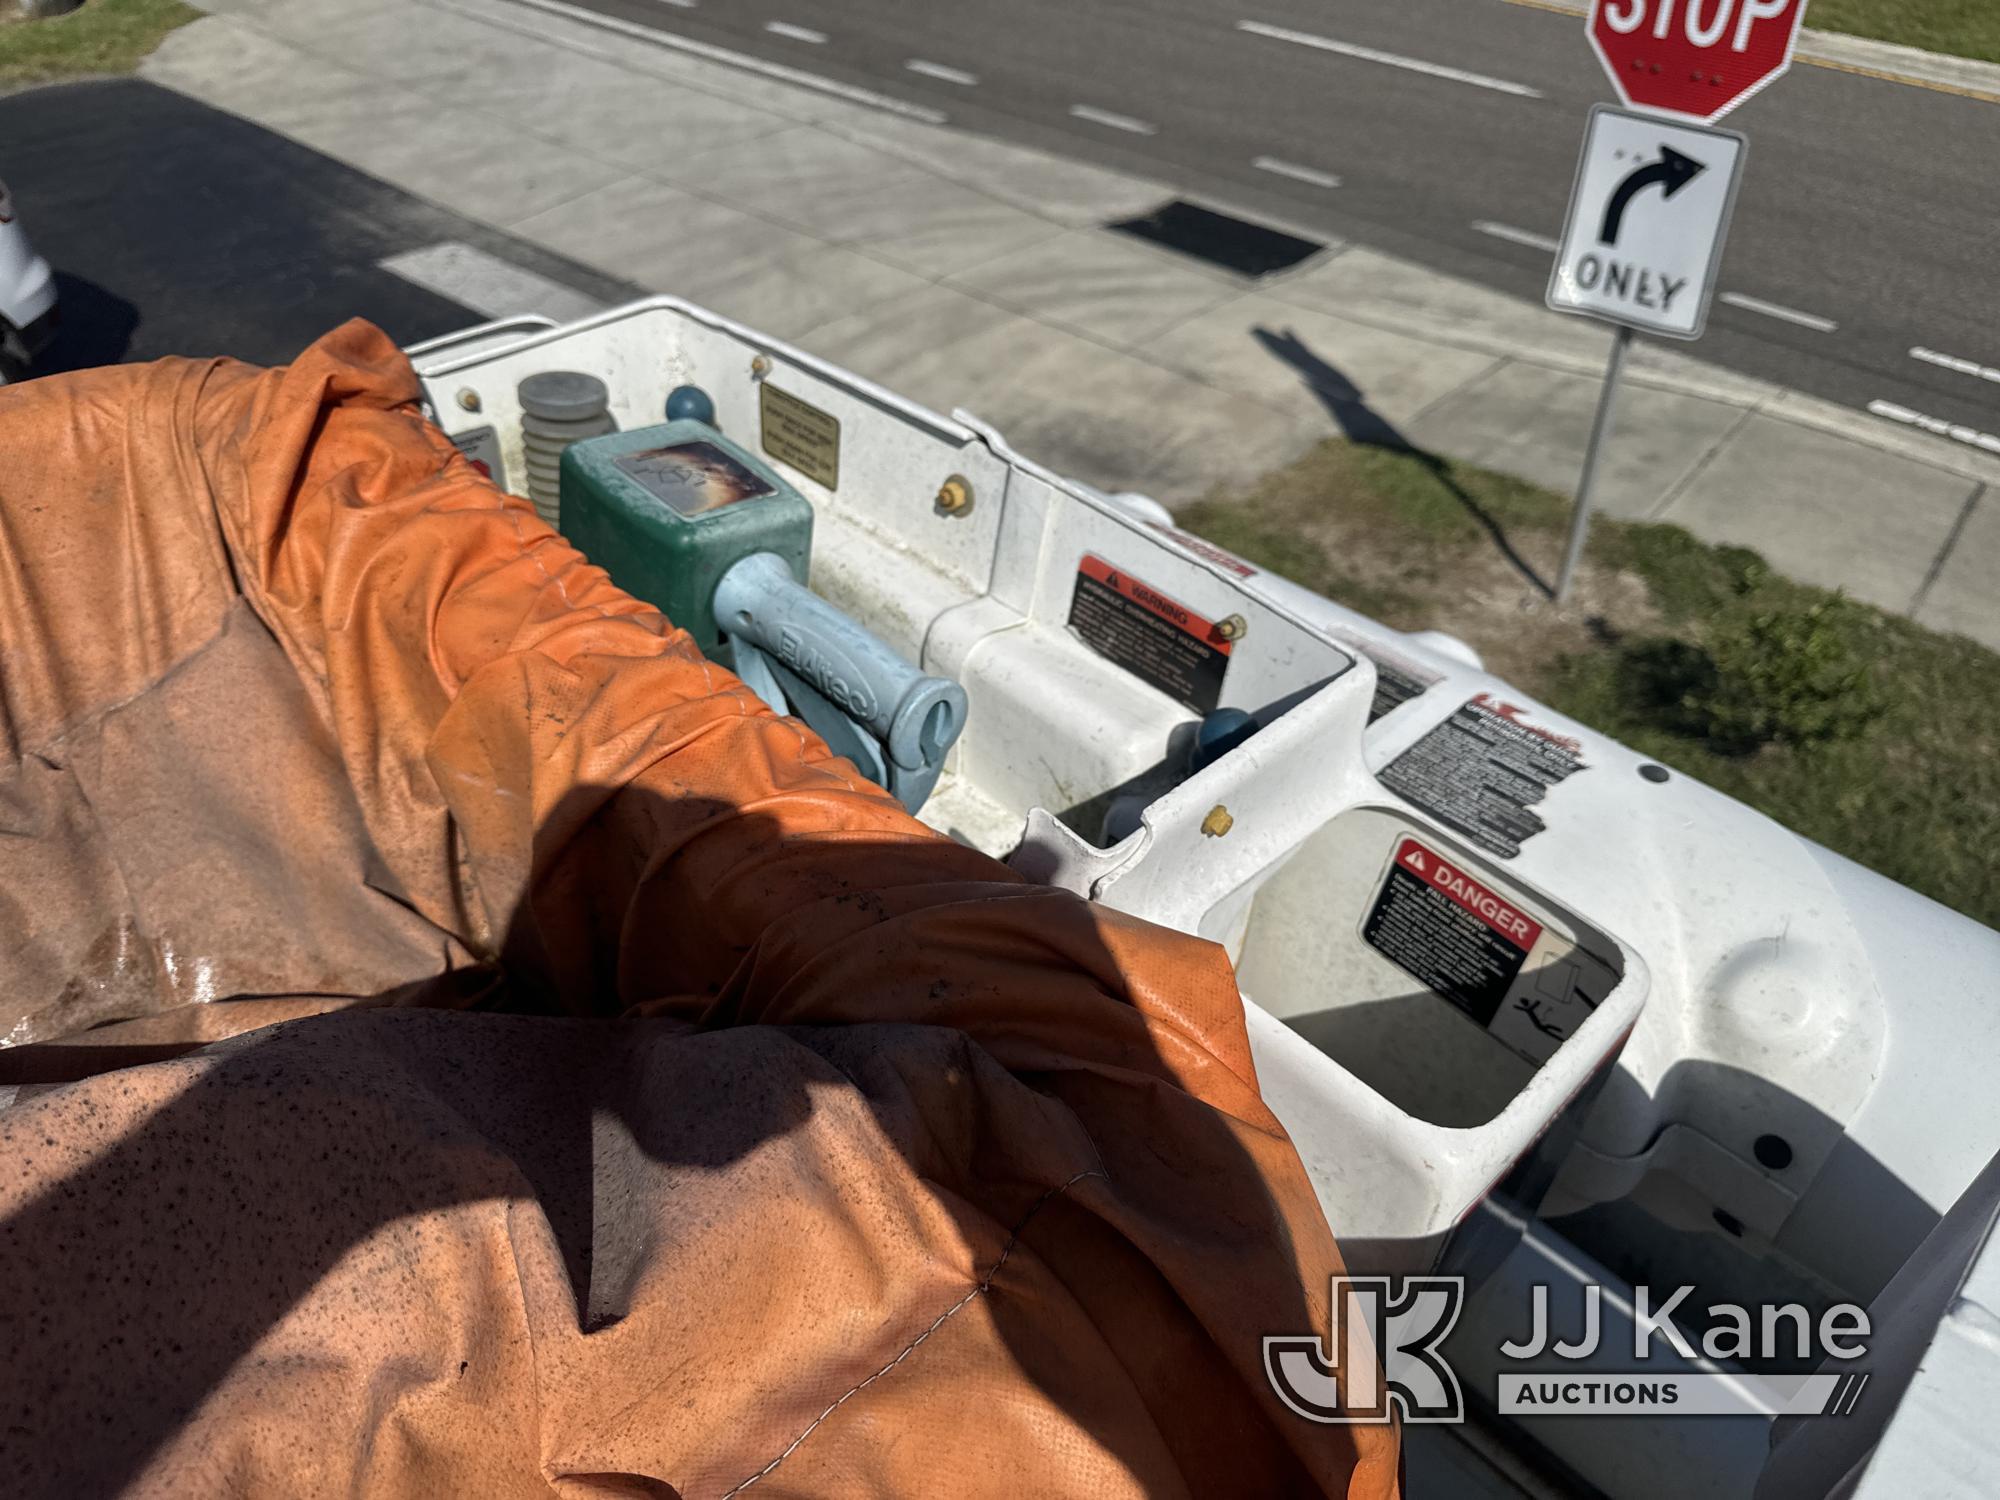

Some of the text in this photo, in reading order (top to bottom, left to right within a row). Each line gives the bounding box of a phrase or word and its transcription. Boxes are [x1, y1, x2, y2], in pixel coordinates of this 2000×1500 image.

[1577, 253, 1686, 312] ONLY
[1131, 586, 1187, 624] WARNING
[1426, 886, 1488, 931] FALL HAZARD
[1433, 866, 1529, 938] DANGER
